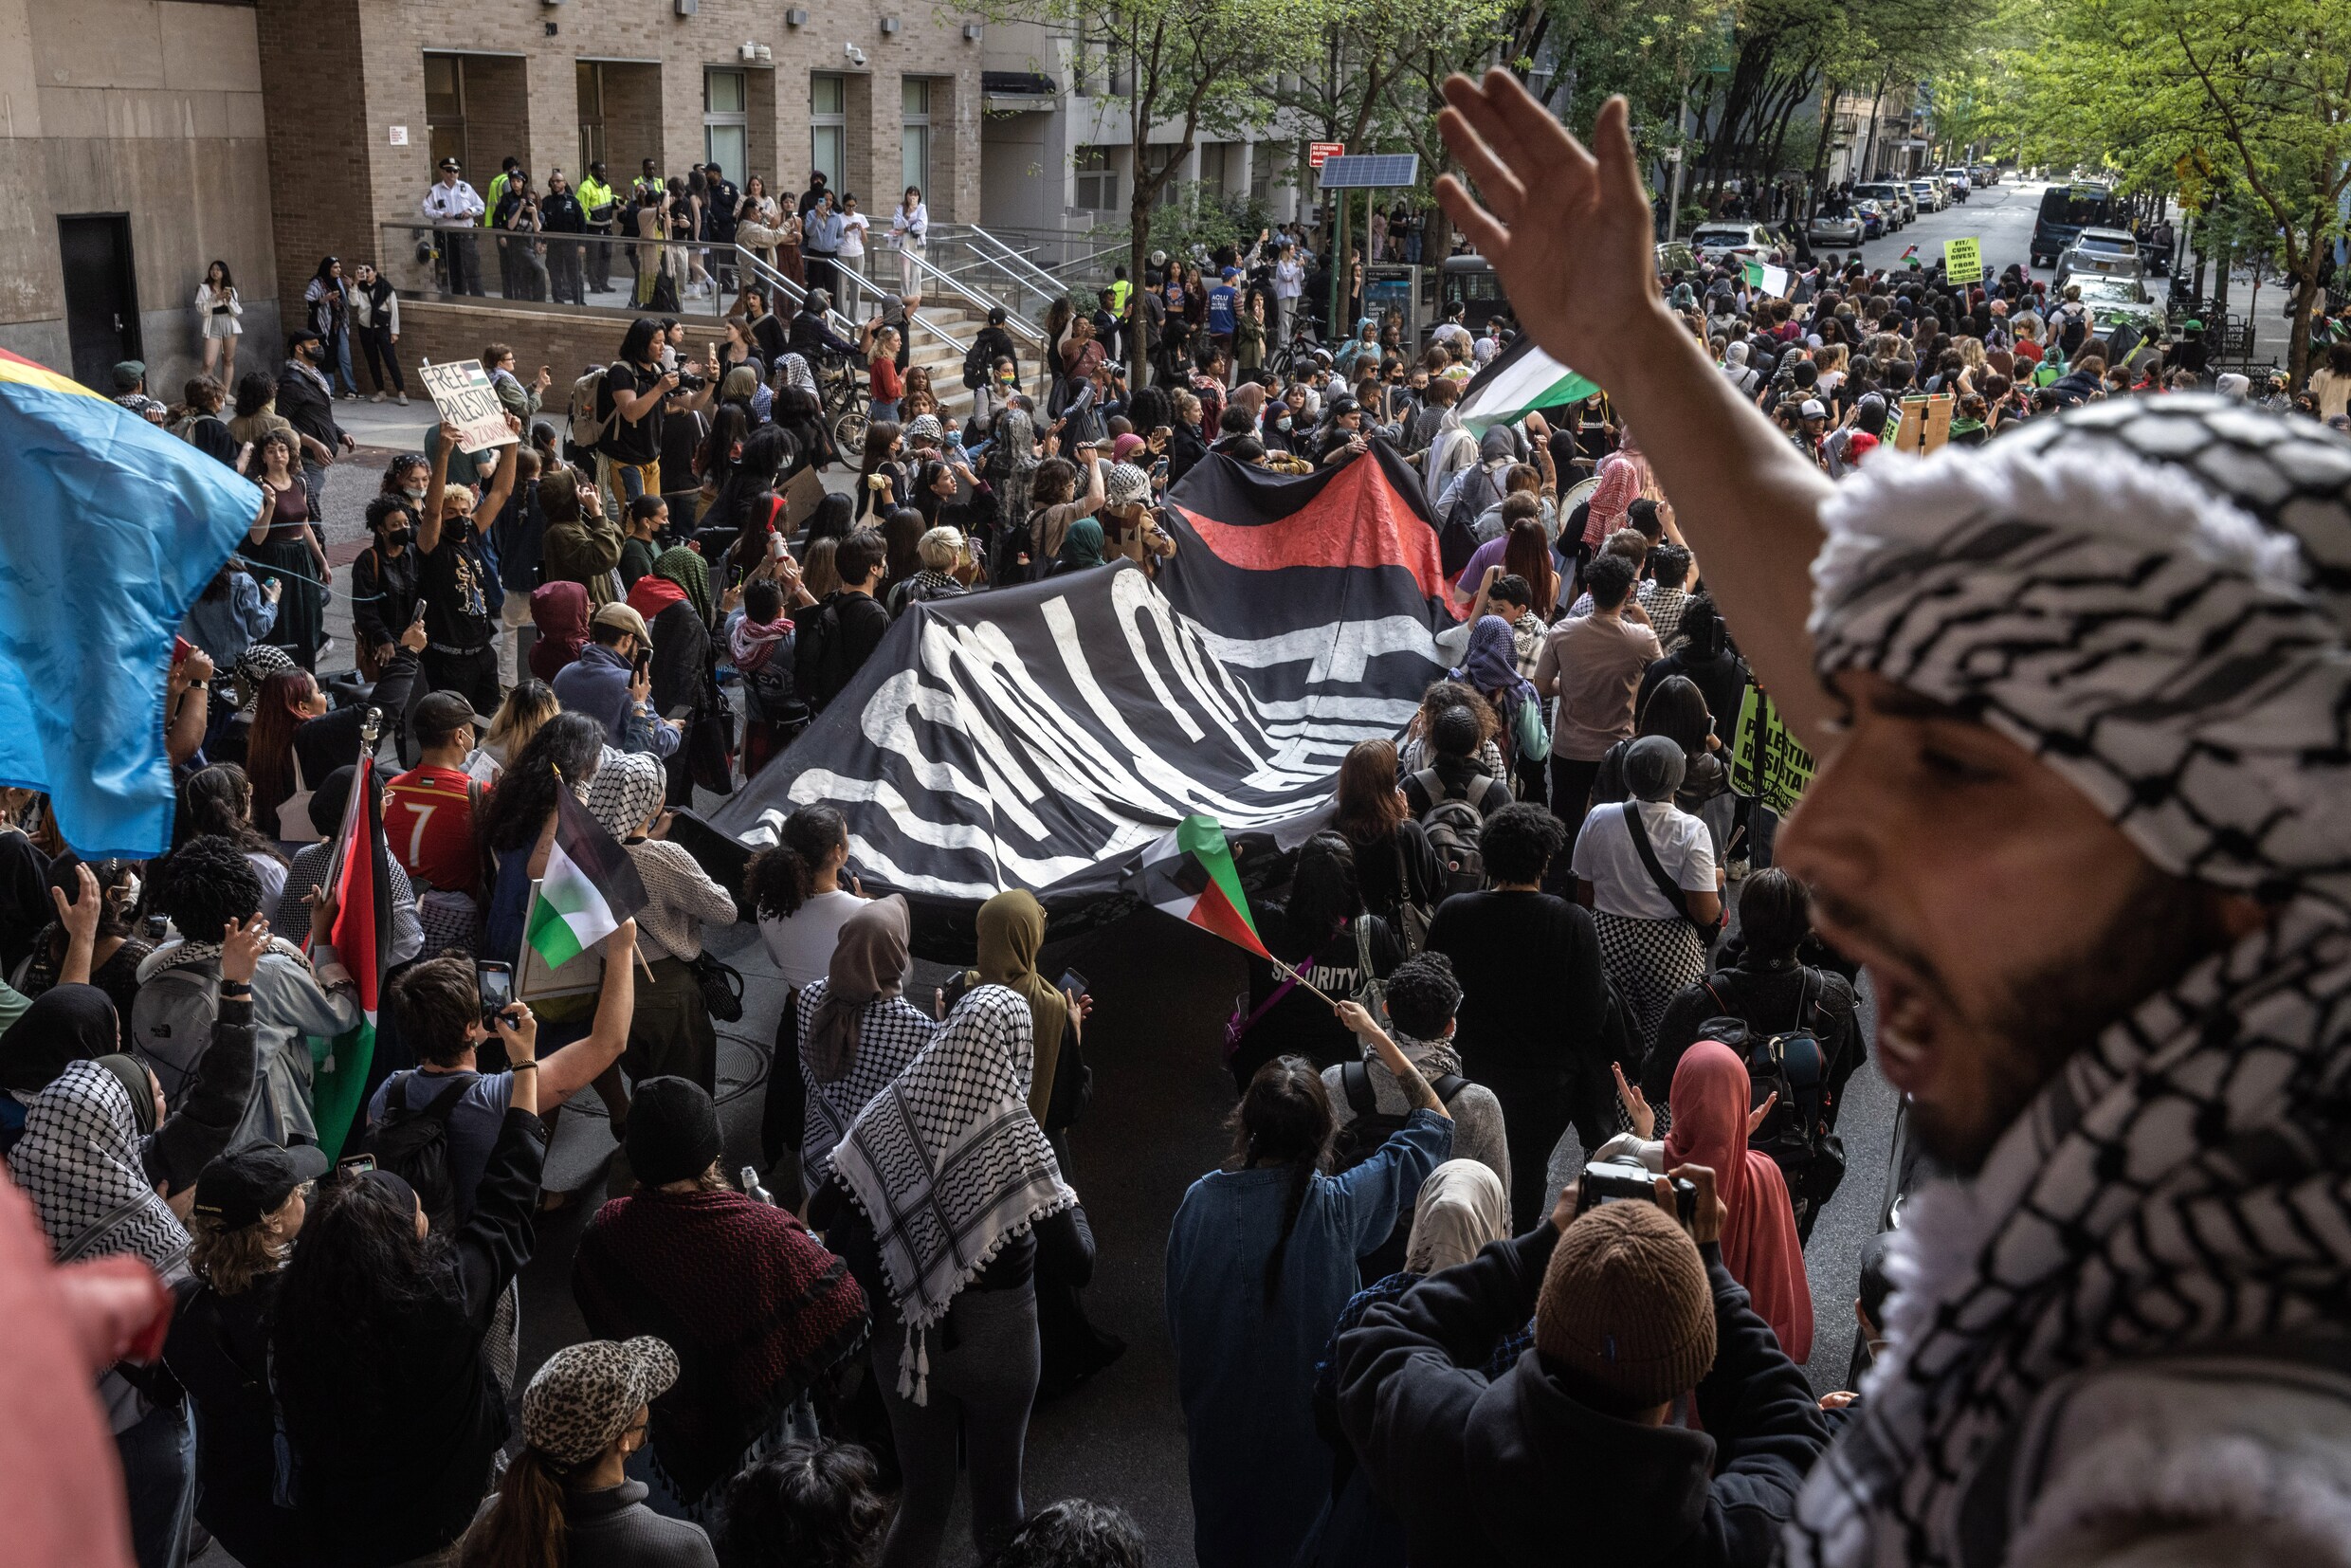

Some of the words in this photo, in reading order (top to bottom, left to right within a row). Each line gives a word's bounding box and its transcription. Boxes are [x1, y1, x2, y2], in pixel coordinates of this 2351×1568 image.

[1153, 254, 1162, 263] FIT
[421, 363, 469, 394] FREE
[436, 387, 503, 425] PALESTINE
[1744, 717, 1815, 773] PLESTIN
[1741, 741, 1809, 793] RSISTA
[1748, 771, 1795, 808] WRKERS
[404, 801, 437, 868] 7
